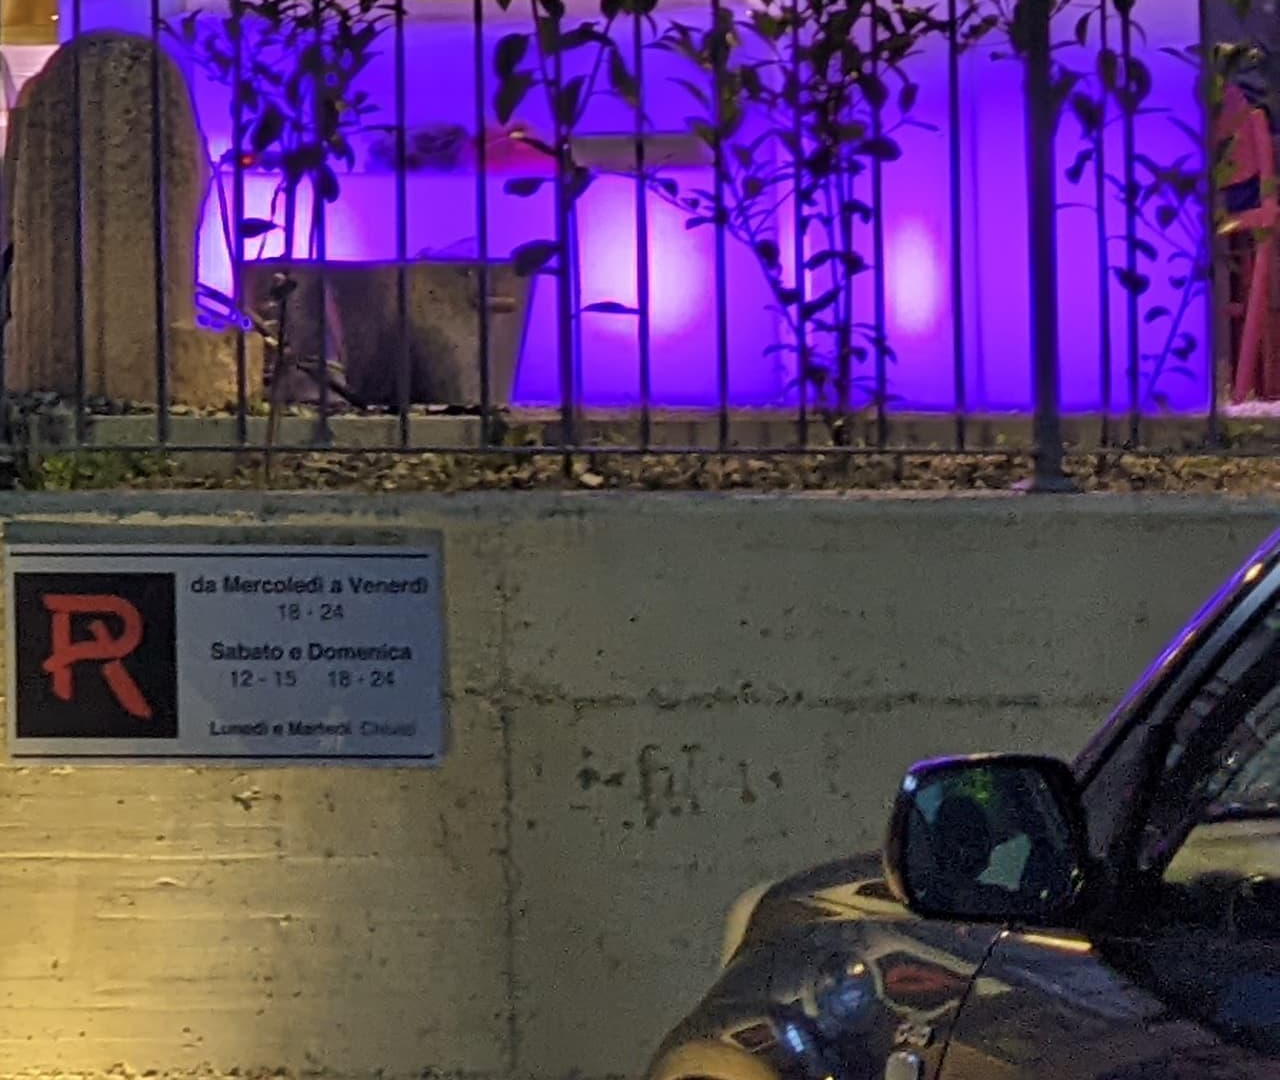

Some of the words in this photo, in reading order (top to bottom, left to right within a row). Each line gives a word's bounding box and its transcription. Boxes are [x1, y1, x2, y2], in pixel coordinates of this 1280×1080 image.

[190, 575, 217, 594] da
[330, 579, 343, 594] a
[278, 603, 301, 621] 18
[320, 603, 344, 621] 24
[210, 642, 283, 661] Sabato
[289, 646, 302, 661] e
[308, 642, 412, 661] Domenica
[230, 670, 254, 688] 12
[275, 670, 297, 688] 15
[328, 670, 350, 688] 18
[370, 670, 396, 688] 24
